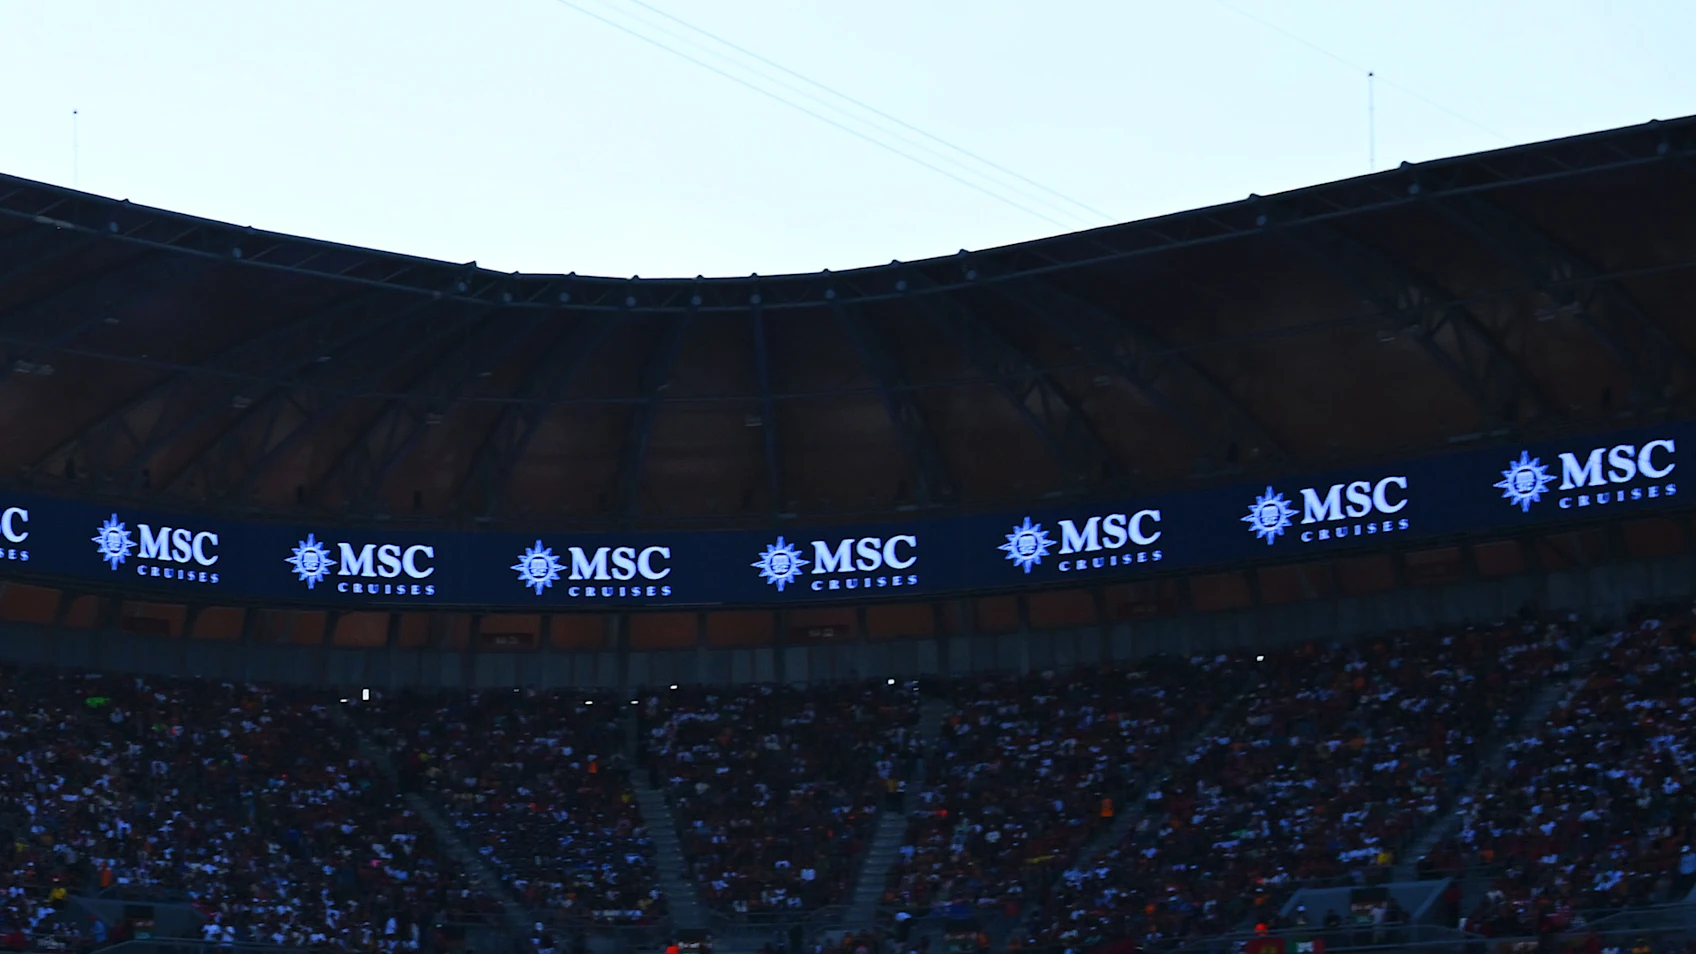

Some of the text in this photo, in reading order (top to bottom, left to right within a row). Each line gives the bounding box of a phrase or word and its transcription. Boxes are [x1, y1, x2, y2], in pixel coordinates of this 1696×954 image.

[1558, 440, 1675, 490] MSC
[1300, 476, 1408, 524] MSC
[1558, 483, 1677, 509] CRUISES
[137, 524, 218, 565] MSC
[1058, 510, 1161, 554] MSC
[1300, 518, 1410, 543] CRUISES
[338, 543, 434, 578] MSC
[568, 546, 671, 580] MSC
[811, 535, 917, 574] MSC
[1058, 549, 1163, 572] CRUISES
[136, 564, 220, 584] CRUISES
[337, 581, 436, 596] CRUISES
[810, 574, 919, 591] CRUISES
[567, 585, 672, 597] CRUISES
